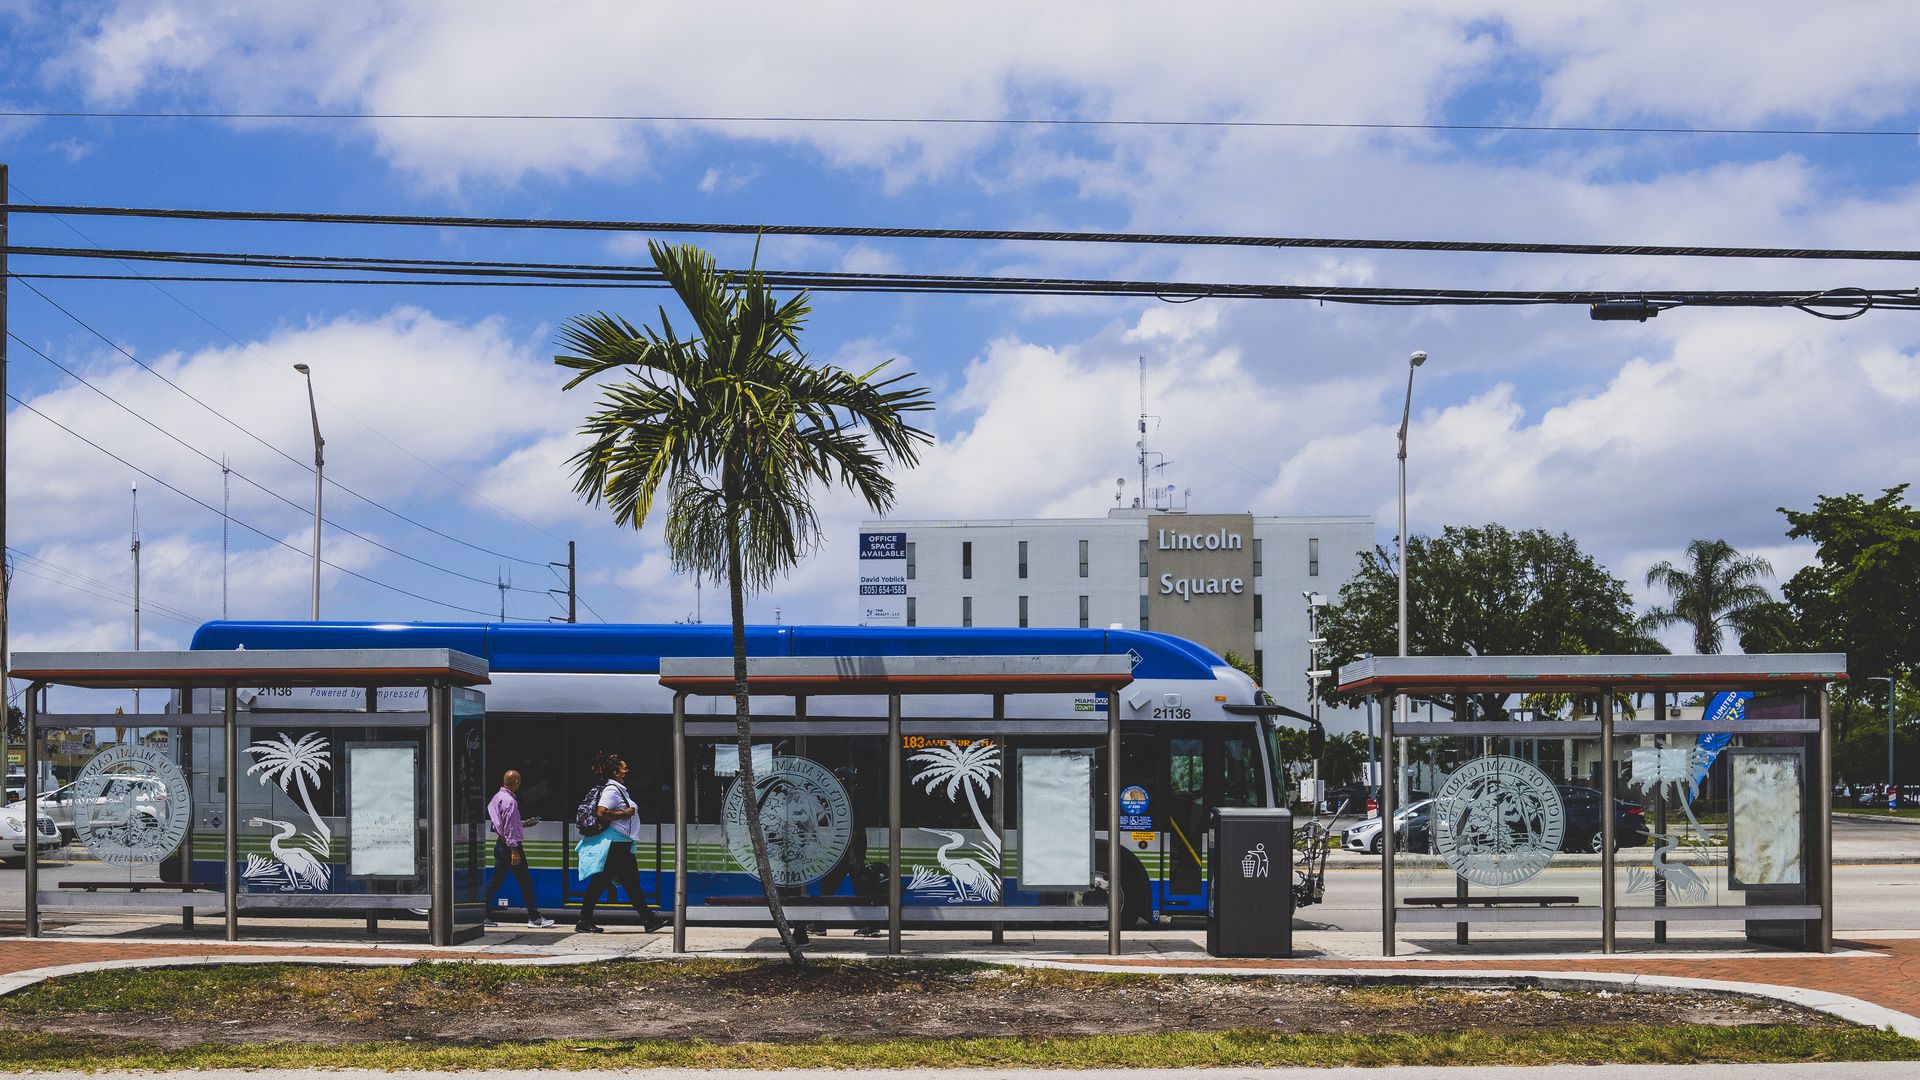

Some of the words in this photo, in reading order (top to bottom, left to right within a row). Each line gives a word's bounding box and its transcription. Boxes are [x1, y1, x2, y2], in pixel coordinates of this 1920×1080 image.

[1158, 529, 1242, 550] Lincoln
[861, 586, 878, 595] (305)
[879, 586, 905, 594] 654-1585
[1160, 573, 1243, 601] Square
[258, 687, 292, 697] 21136
[310, 688, 347, 697] Powered
[351, 688, 361, 699] by
[1153, 709, 1191, 719] 21136
[903, 735, 924, 748] 183
